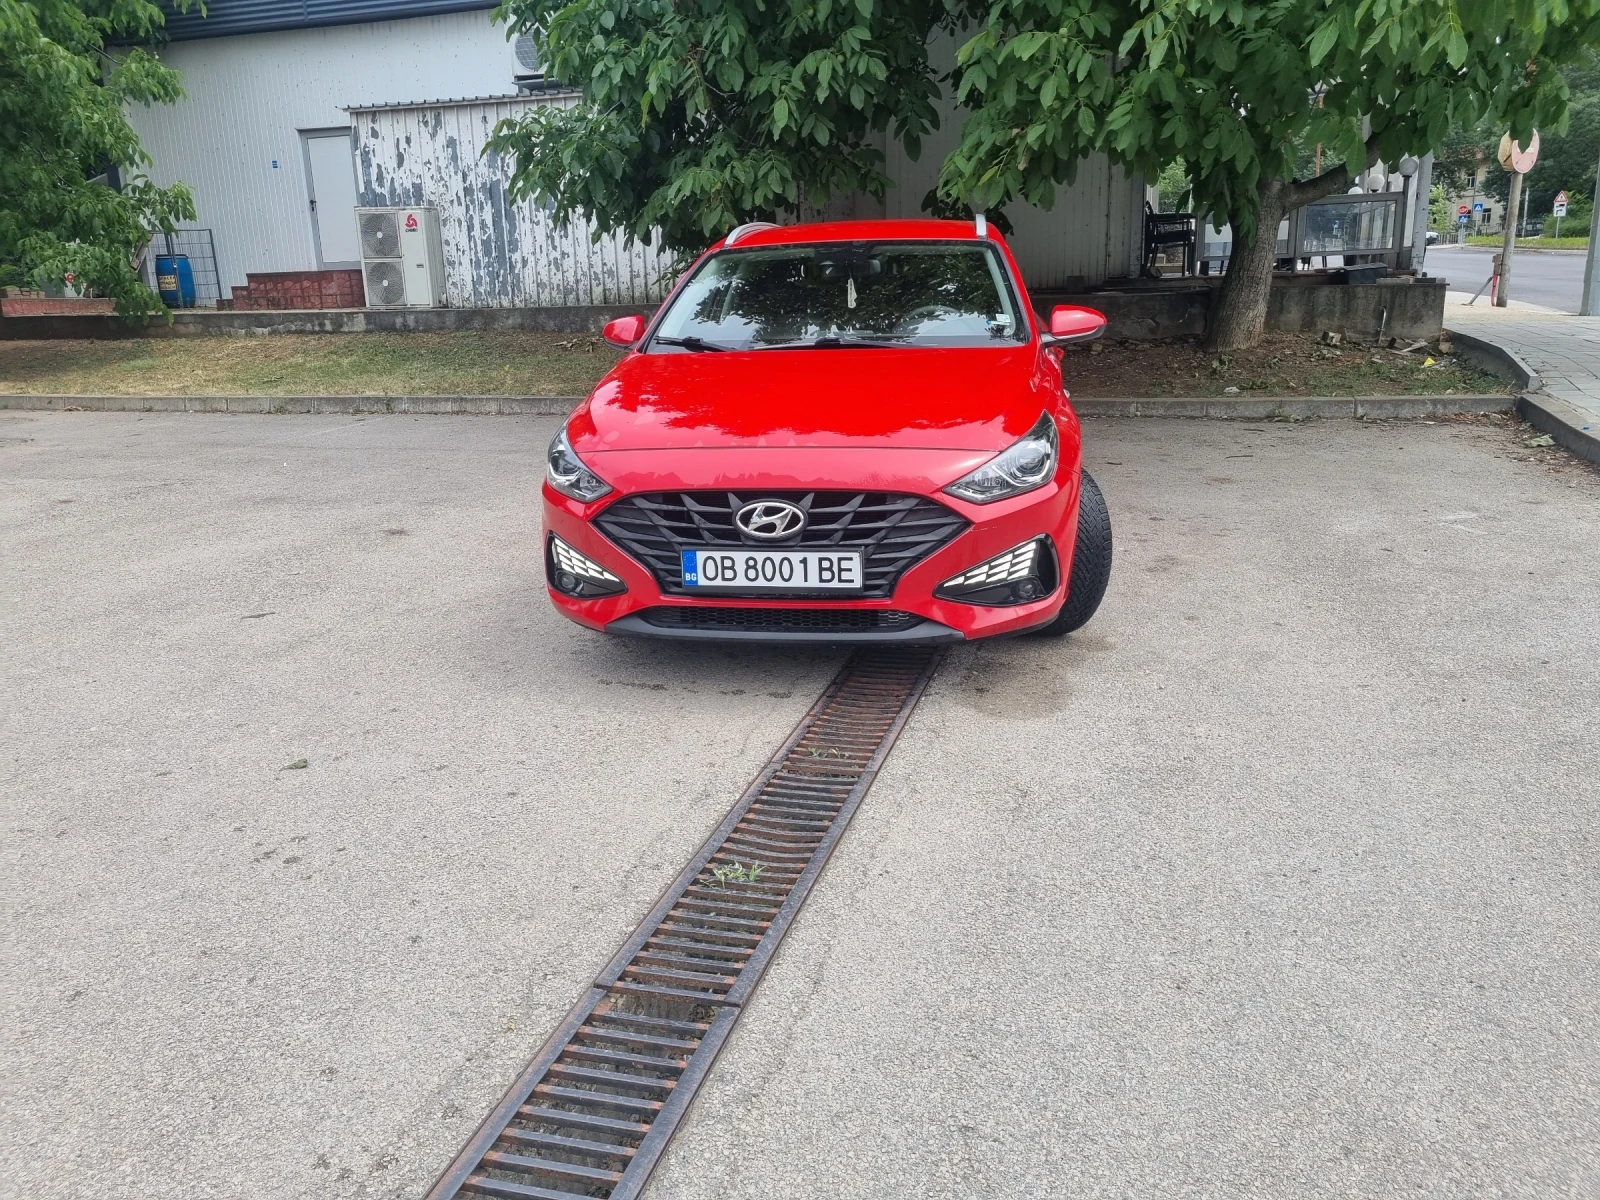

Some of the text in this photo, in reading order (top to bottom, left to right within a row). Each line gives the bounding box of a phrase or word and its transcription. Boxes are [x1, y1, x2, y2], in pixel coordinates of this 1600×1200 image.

[685, 572, 697, 581] BG
[702, 555, 854, 584] OB 8001 BE
